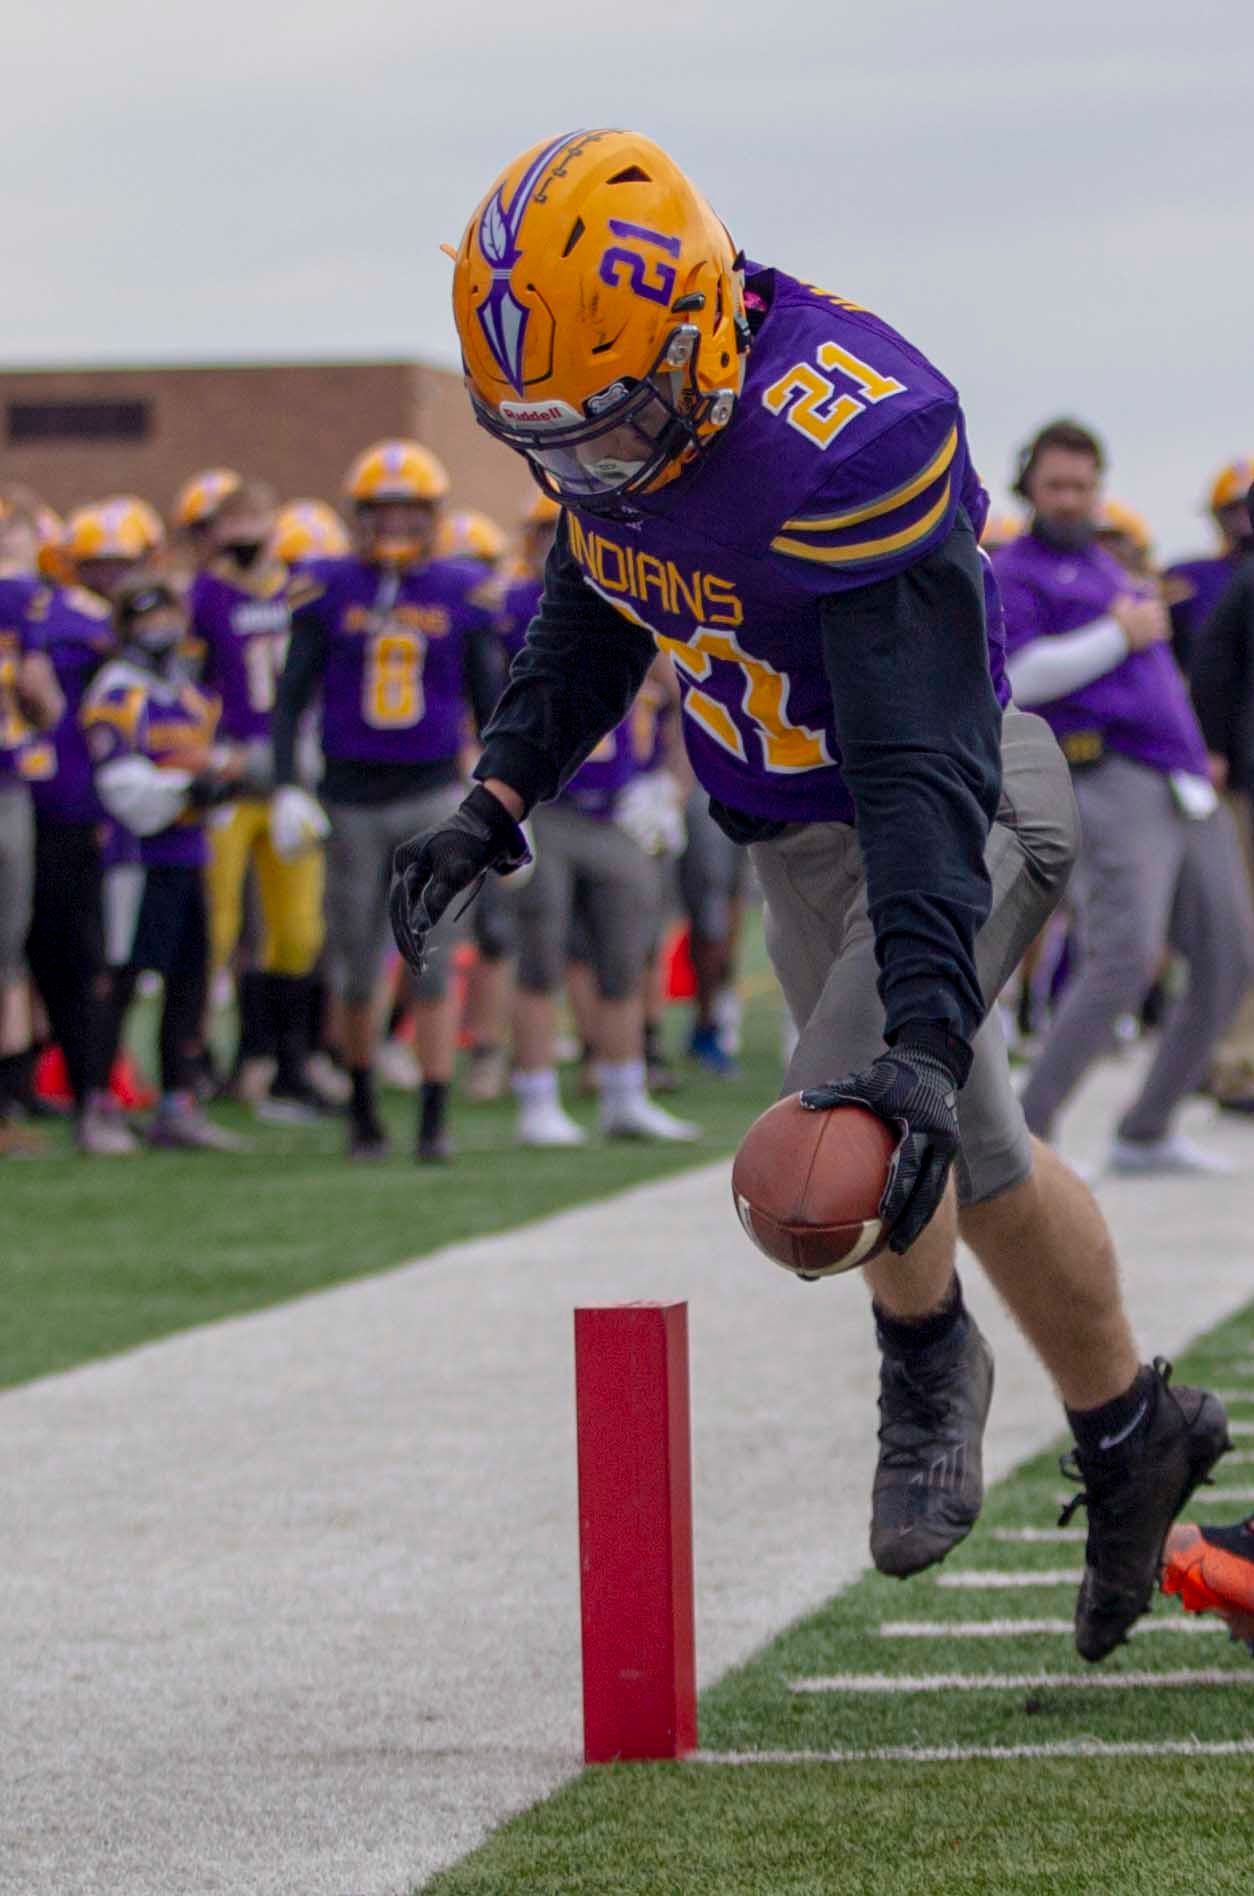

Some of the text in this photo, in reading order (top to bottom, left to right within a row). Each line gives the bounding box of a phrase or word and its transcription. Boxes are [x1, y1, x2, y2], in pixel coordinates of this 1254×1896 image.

[599, 219, 681, 307] 21
[503, 407, 562, 422] Riddell
[762, 341, 908, 450] 21
[567, 510, 744, 625] INDIANS
[362, 627, 428, 731] 8
